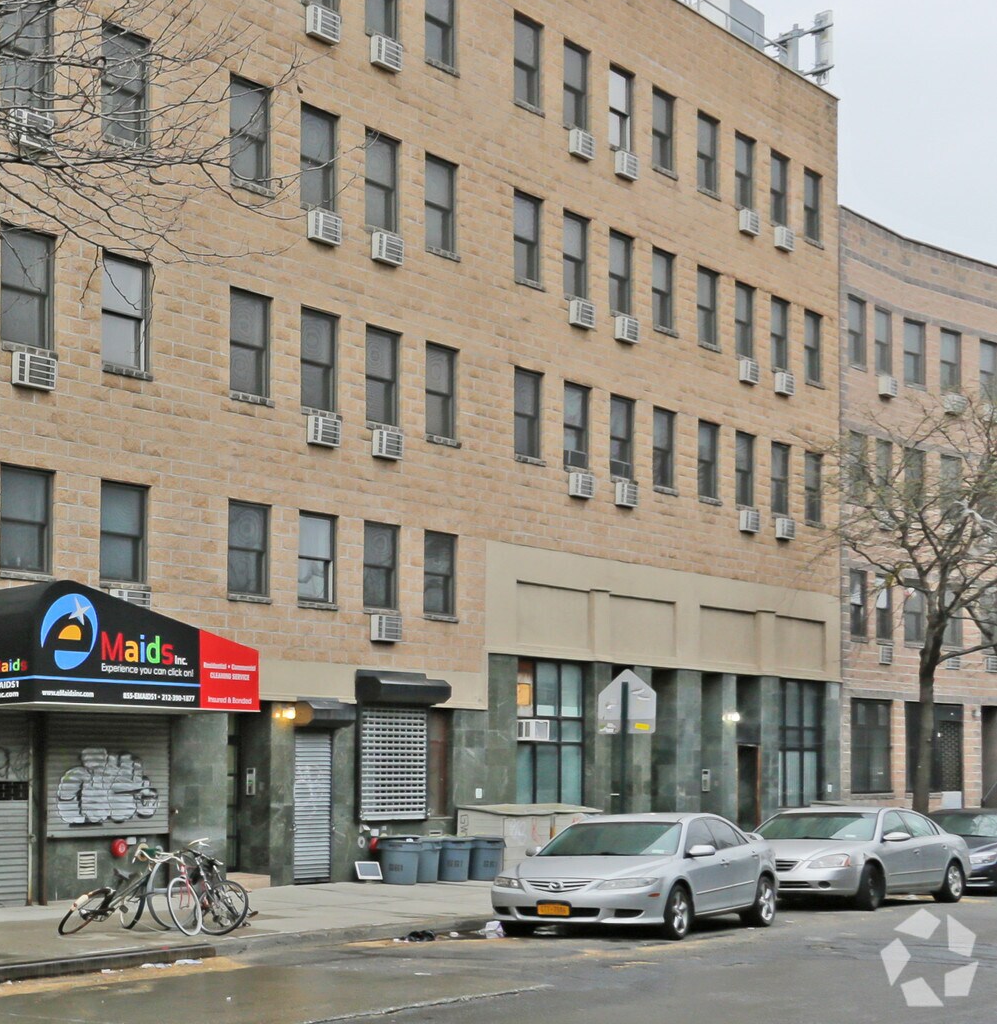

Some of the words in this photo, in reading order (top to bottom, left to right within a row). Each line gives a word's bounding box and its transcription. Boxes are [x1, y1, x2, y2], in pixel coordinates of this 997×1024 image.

[101, 631, 174, 665] Maids
[174, 655, 188, 665] Inc.
[101, 663, 139, 674] Experience
[139, 667, 153, 676] you
[154, 667, 166, 675] can
[168, 667, 183, 677] click
[184, 668, 194, 678] on!
[232, 673, 250, 681] SERVICE
[208, 696, 227, 704] Insured
[232, 696, 252, 705] Bonded
